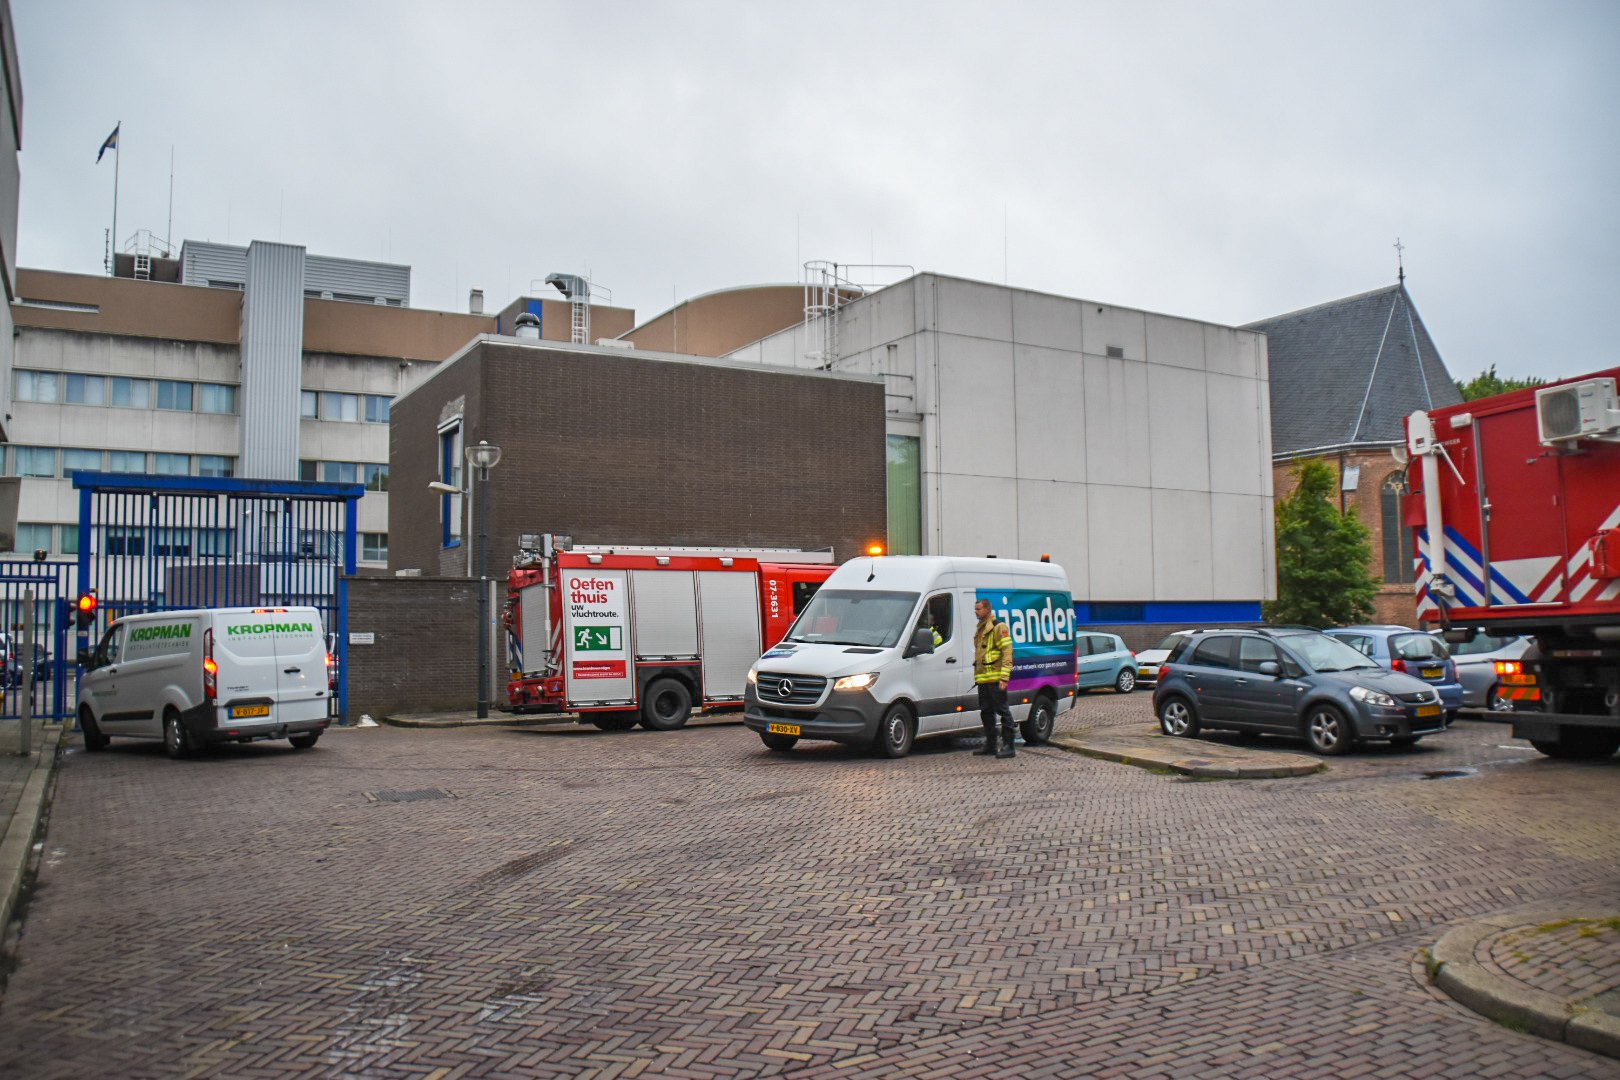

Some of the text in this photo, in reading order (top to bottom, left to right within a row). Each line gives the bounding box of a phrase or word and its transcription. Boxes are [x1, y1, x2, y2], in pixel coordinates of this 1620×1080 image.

[570, 577, 614, 590] Oefen
[571, 590, 608, 603] thuis
[769, 580, 779, 618] 07-3631
[571, 610, 619, 618] vluchtroute.
[991, 596, 1076, 643] iander
[130, 623, 192, 642] KROPMAN
[227, 623, 313, 635] KROPMAN
[770, 724, 798, 734] V-830-XV
